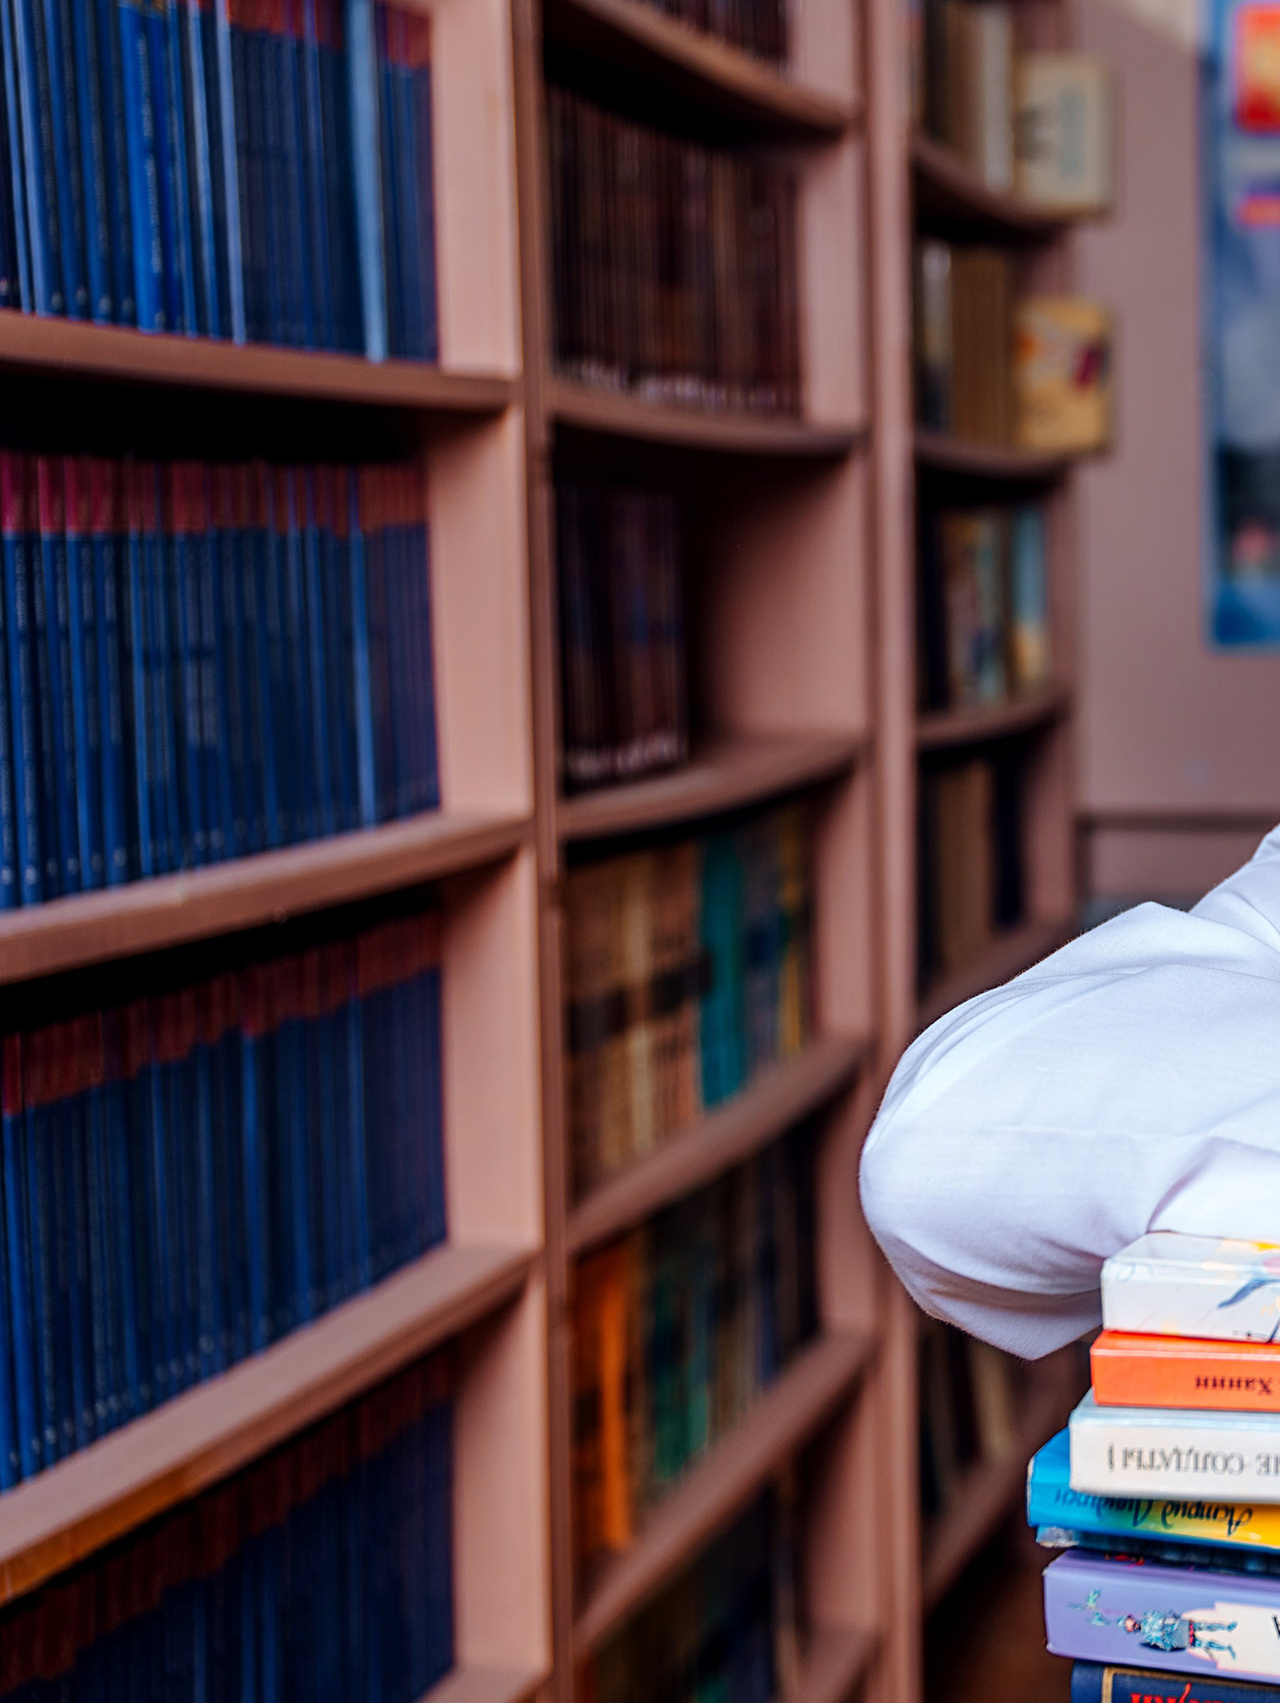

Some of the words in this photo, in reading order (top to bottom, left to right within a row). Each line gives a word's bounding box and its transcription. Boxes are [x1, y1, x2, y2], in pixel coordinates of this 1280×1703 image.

[1194, 1375, 1273, 1396] Ханин
[1122, 1448, 1244, 1476] СОЛДАТЫ
[1160, 1500, 1253, 1538] Астрид
